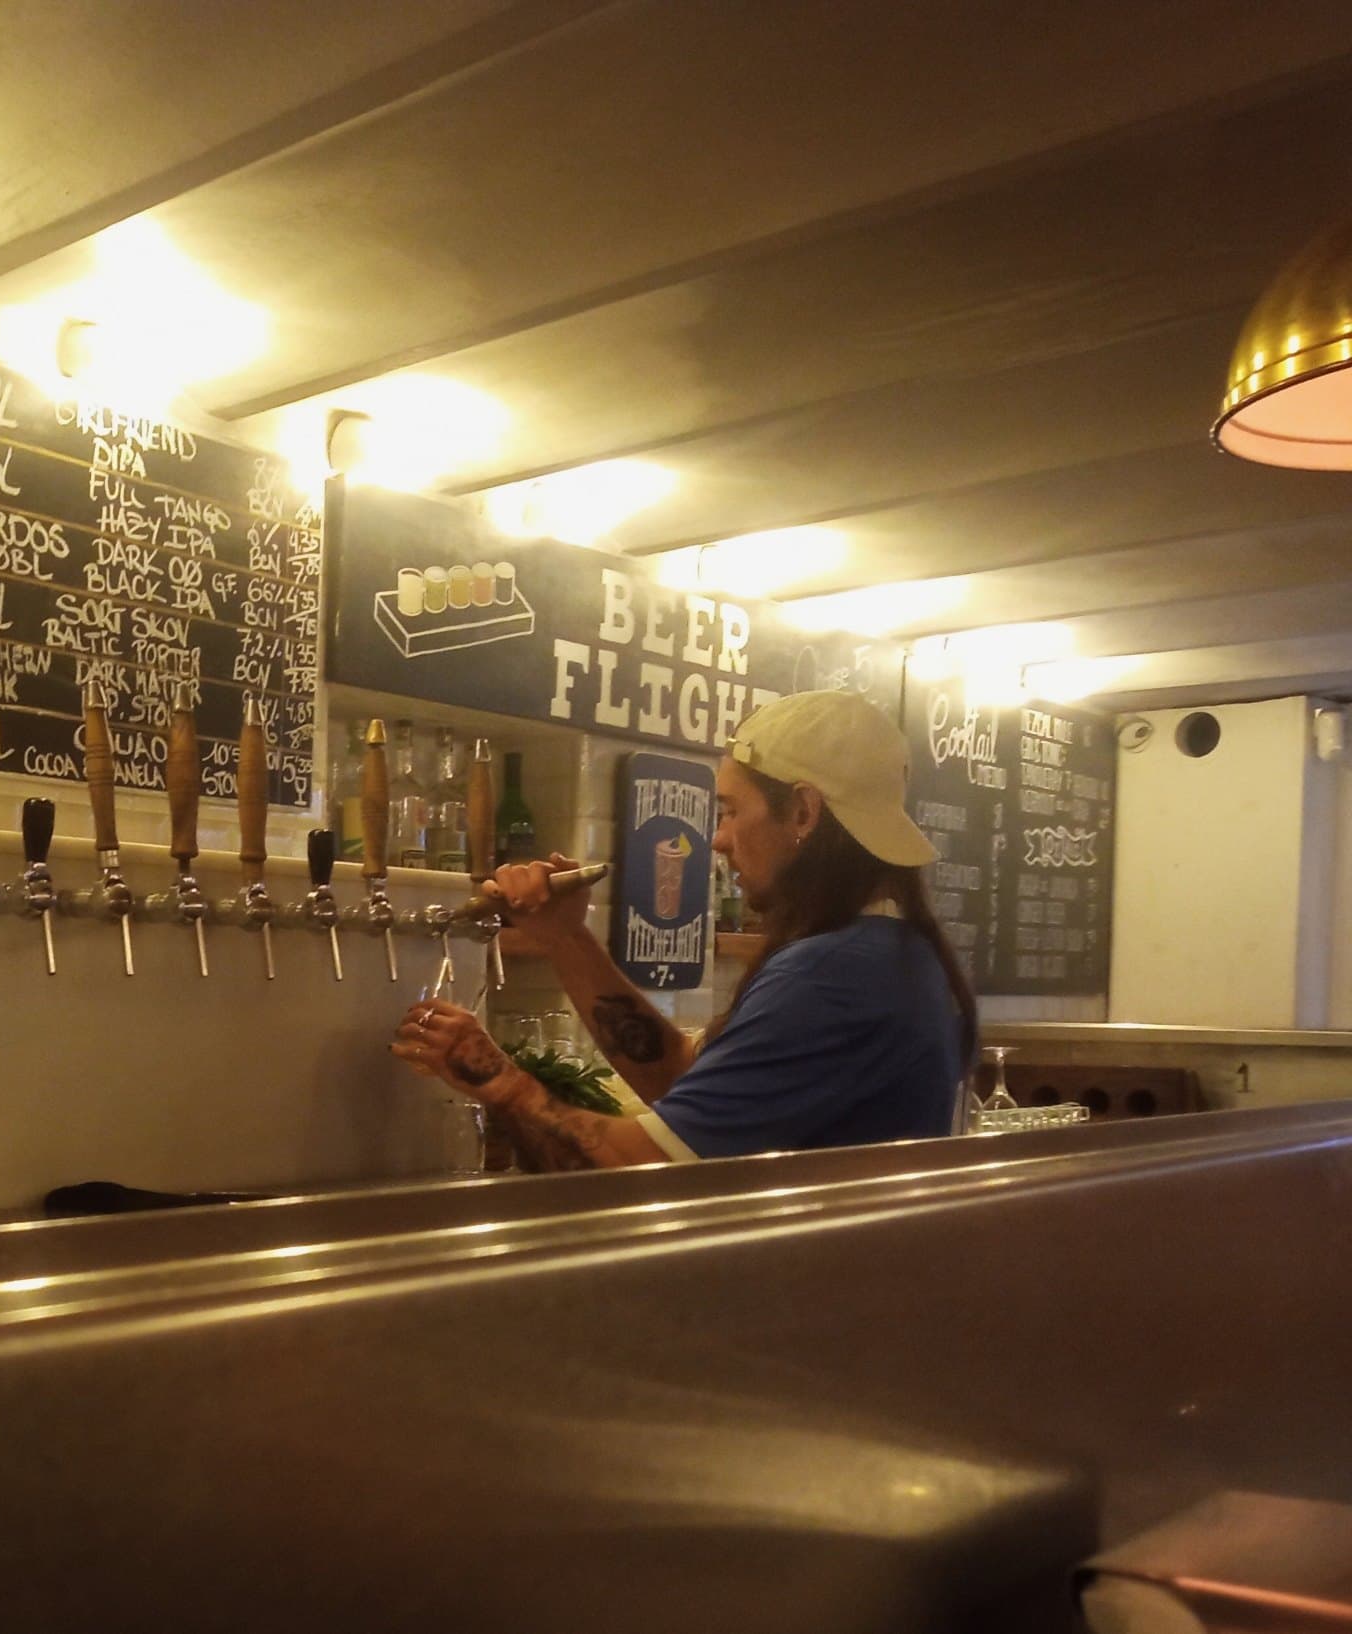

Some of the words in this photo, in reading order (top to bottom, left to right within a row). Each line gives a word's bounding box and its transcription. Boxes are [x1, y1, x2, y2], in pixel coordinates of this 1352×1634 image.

[92, 436, 147, 480] DIPA
[88, 466, 147, 509] FULL
[153, 494, 232, 534] TANGO
[96, 503, 162, 545] HAZY
[163, 524, 217, 559] IPA
[92, 537, 166, 575] DARK
[82, 562, 168, 603] BLACK
[169, 585, 217, 620] IPA
[130, 607, 192, 648] SKOV
[598, 567, 749, 676] BEER
[75, 659, 132, 695] DARK
[130, 638, 202, 685] PORTER
[23, 744, 80, 779] COCOA
